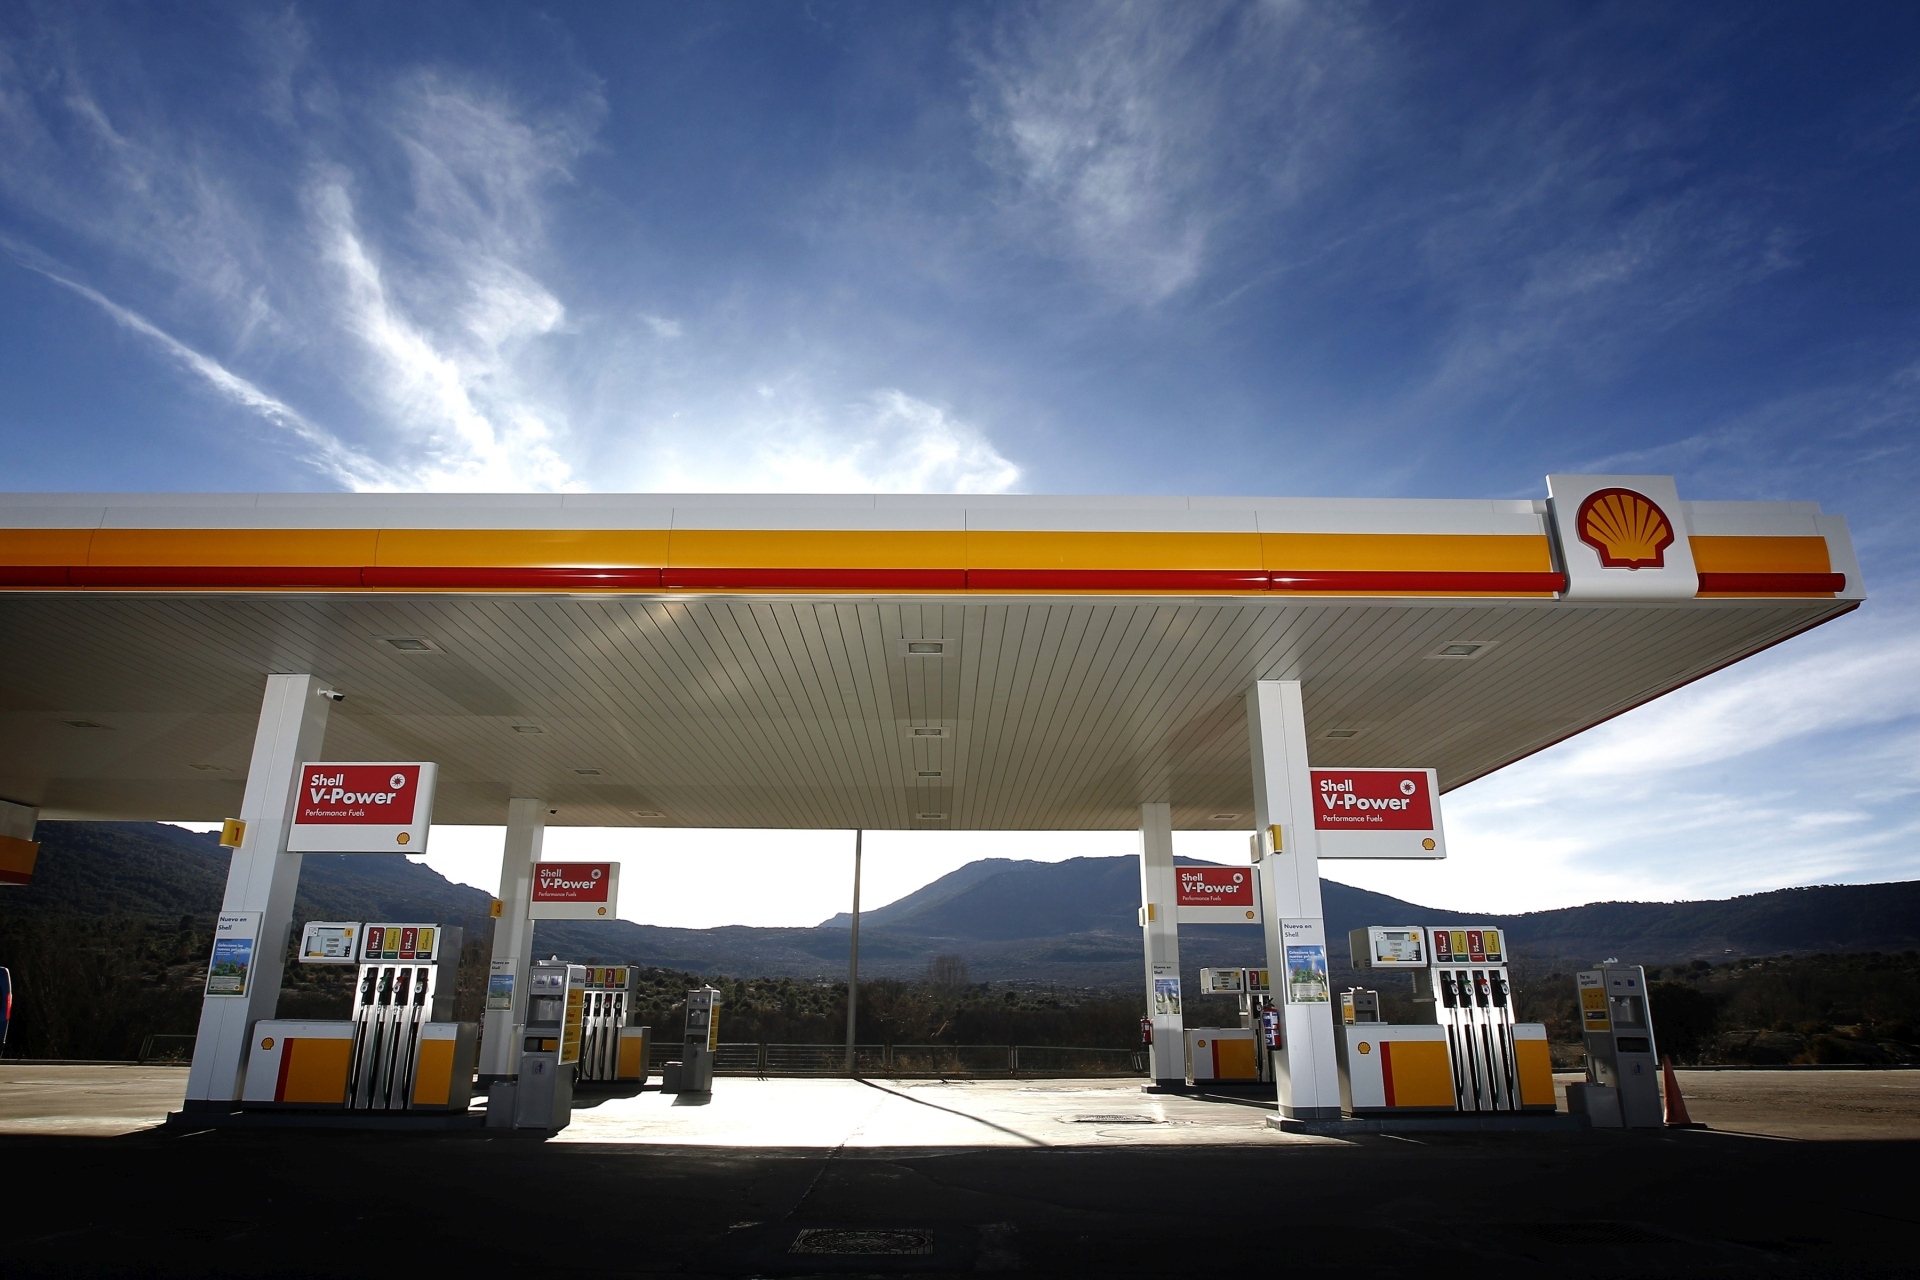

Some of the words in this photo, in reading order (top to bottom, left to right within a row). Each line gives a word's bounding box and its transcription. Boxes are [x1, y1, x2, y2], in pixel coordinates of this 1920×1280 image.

[310, 773, 344, 786] Shell
[1320, 779, 1353, 792] Shell
[310, 787, 397, 804] V-Power
[1321, 793, 1410, 810] V-Power
[305, 808, 347, 817] Performance
[348, 808, 365, 817] Fuels
[1322, 814, 1365, 822] Performance
[1366, 814, 1383, 822] Fuels
[234, 827, 240, 841] 1
[540, 868, 562, 877] Shell
[1181, 873, 1203, 881] Shell
[540, 878, 596, 889] V-Power
[1182, 882, 1239, 893] V-Power
[496, 904, 501, 914] 3
